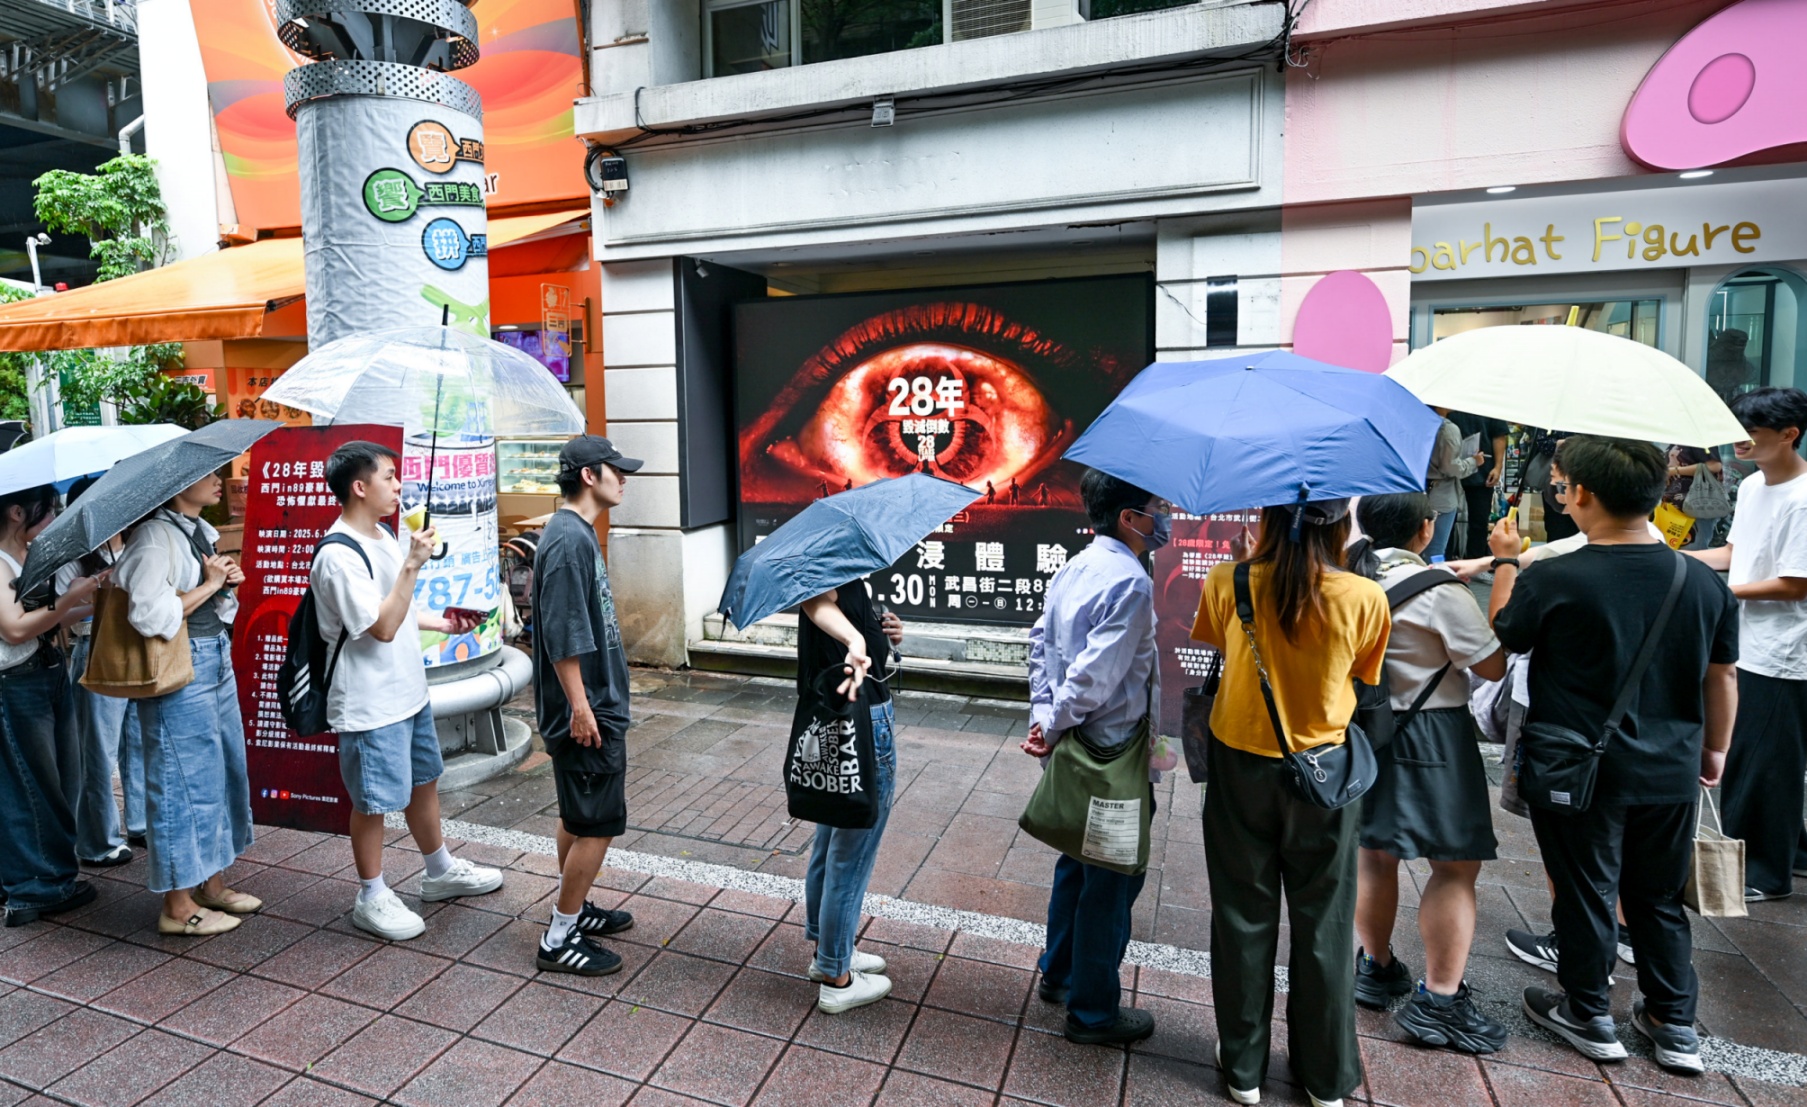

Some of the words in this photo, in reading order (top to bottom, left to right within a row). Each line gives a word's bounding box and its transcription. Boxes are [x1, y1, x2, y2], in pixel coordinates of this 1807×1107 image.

[1592, 217, 1761, 262] Figure
[888, 376, 964, 417] 28年
[902, 419, 950, 434] 毀滅倒數
[917, 435, 935, 448] 28
[417, 482, 466, 492] Welcome
[468, 480, 477, 489] to
[277, 496, 342, 507] 恐怖懼獻最終
[263, 575, 310, 585] (欲購買本場次
[928, 574, 936, 608] MON
[840, 718, 859, 775] BAR
[803, 762, 840, 776] AWAKE
[802, 771, 863, 794] SOBER
[290, 792, 302, 800] Sony
[1092, 800, 1125, 809] MASTER
